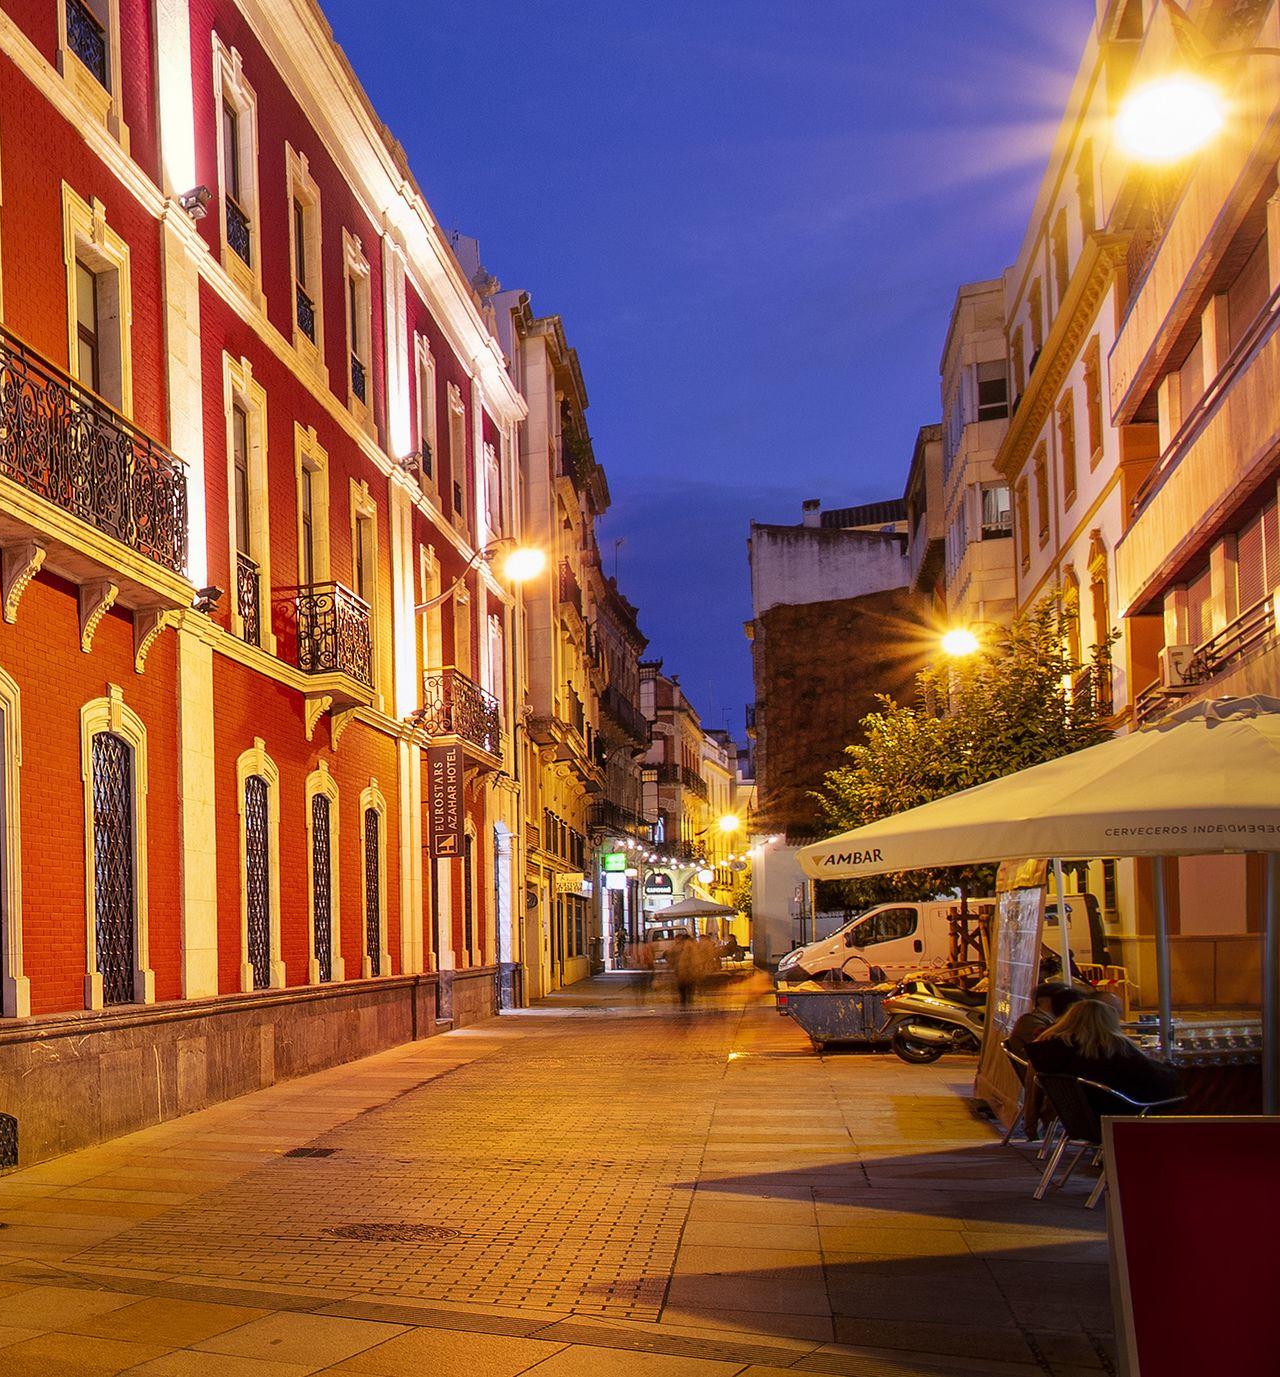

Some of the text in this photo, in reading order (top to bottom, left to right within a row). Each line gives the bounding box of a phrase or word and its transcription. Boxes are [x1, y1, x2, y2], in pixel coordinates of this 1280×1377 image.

[434, 762, 444, 831] EUROSTARS
[447, 748, 457, 830] AZAHAR HOTEL
[1104, 825, 1188, 837] CERVECEROS
[824, 849, 884, 866] AMBAR
